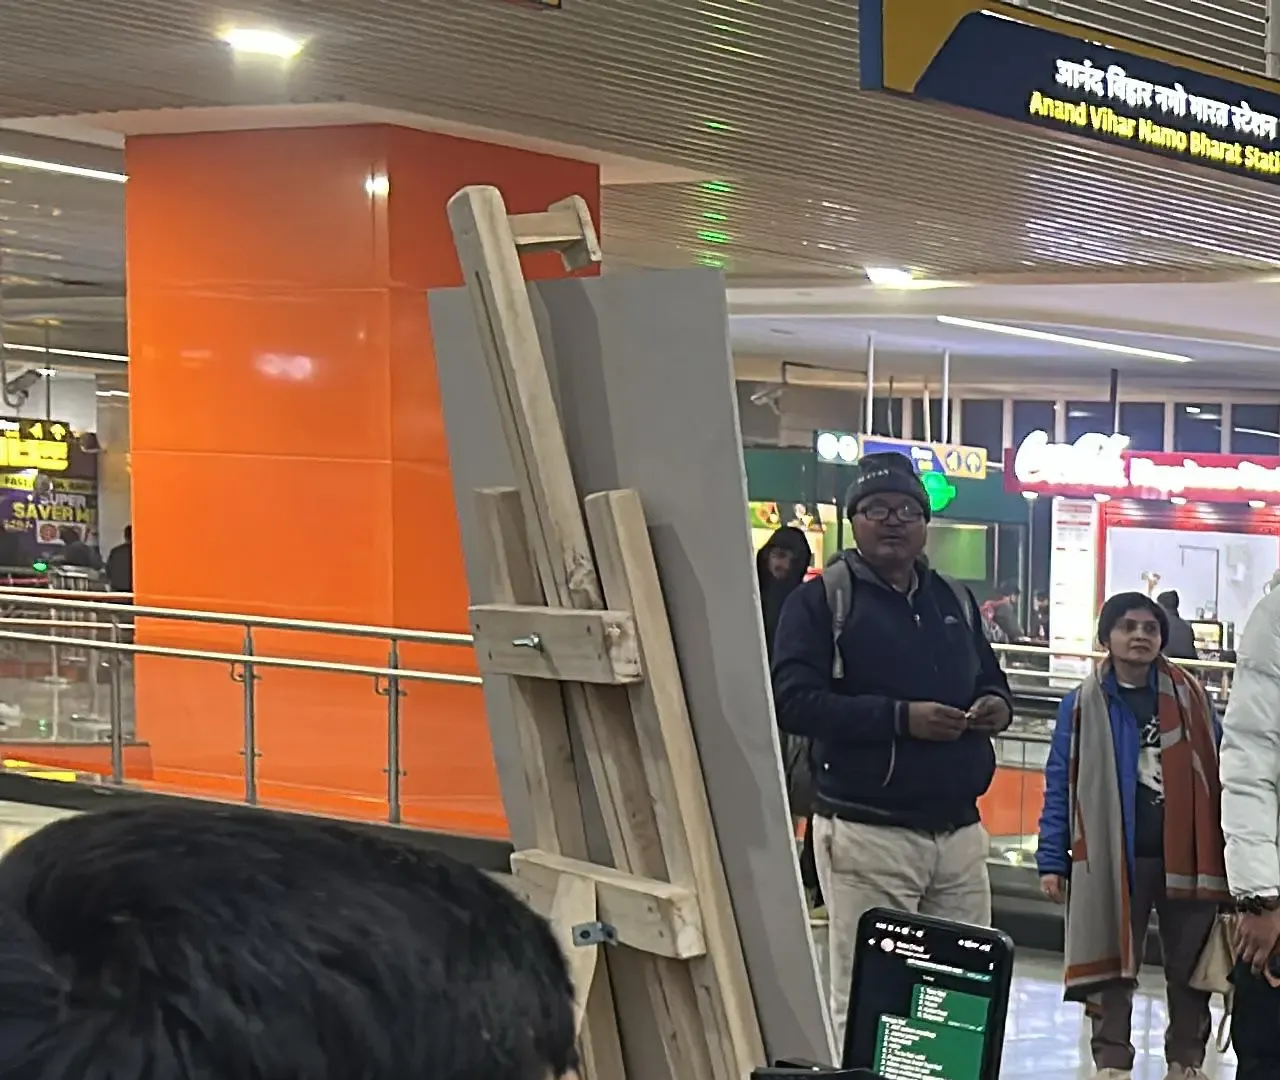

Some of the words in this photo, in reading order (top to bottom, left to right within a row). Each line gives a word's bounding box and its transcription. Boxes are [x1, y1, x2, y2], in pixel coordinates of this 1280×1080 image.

[1029, 90, 1087, 126] Anand
[1089, 105, 1137, 138] Vihar
[1138, 117, 1188, 151] Namo
[1190, 130, 1243, 165] Bharat
[1055, 59, 1105, 97] आनंद
[1106, 64, 1154, 108] विहार
[1154, 82, 1188, 117] नमो
[1188, 94, 1231, 127] भारत
[1230, 100, 1279, 141] स्टेशन
[12, 502, 74, 521] SAVER
